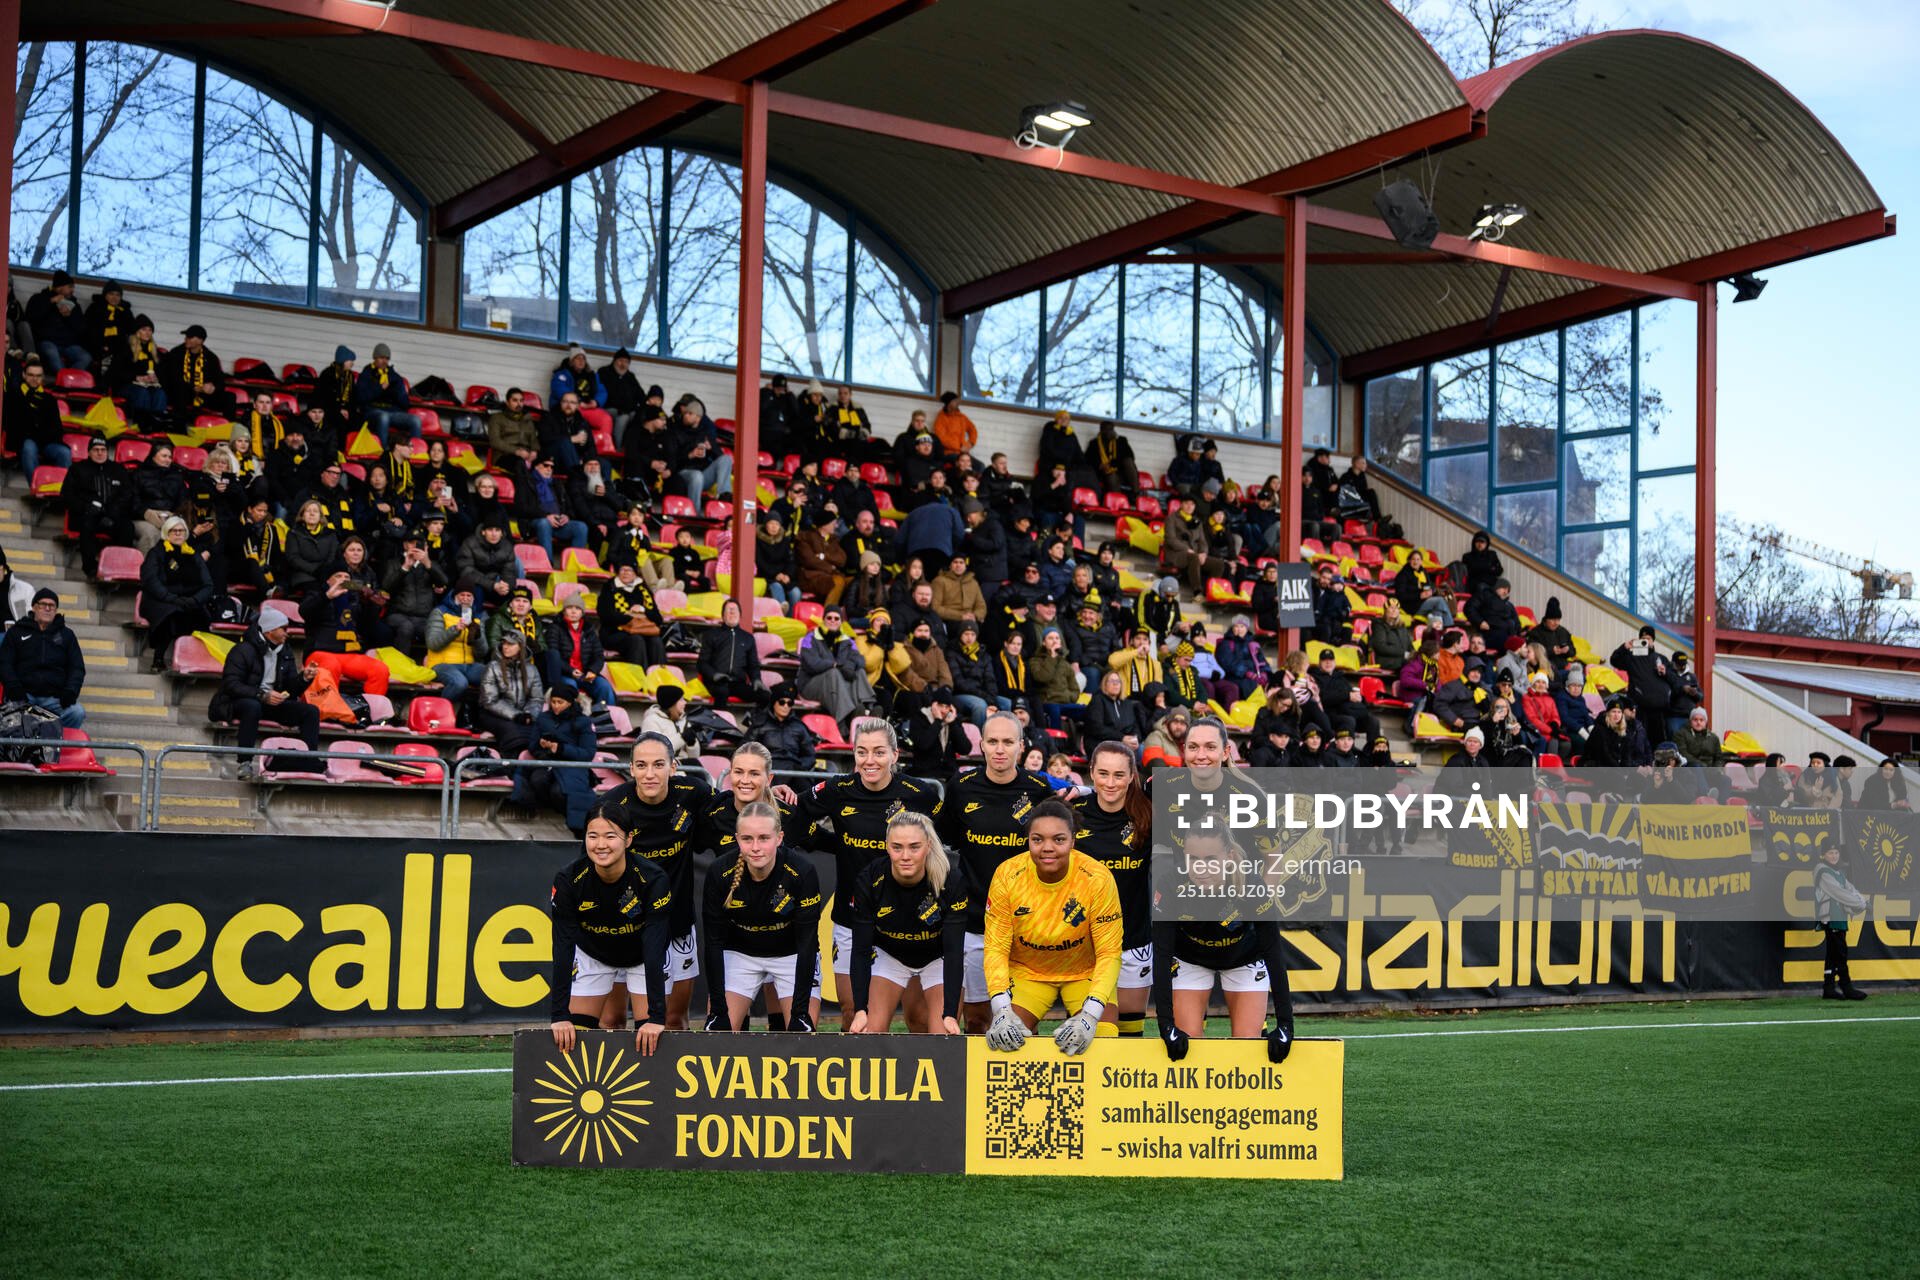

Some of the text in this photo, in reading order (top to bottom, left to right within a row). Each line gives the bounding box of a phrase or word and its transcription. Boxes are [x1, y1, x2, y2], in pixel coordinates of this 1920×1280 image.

[1281, 579, 1310, 600] AIK
[1692, 819, 1747, 840] NORDIN
[1769, 809, 1831, 826] Bevara taket
[966, 829, 1028, 847] truecaller
[1452, 852, 1498, 868] GRABUS!
[1543, 870, 1639, 896] SKYTTAN
[1646, 871, 1751, 899] VÅR KAPTEN
[1019, 936, 1086, 951] truecaller
[675, 1055, 943, 1102] SVARTGULA
[1102, 1066, 1283, 1091] Stötta AIK Fotbolls
[1101, 1100, 1318, 1130] samhällsengagemang
[675, 1114, 855, 1161] FONDEN
[1118, 1136, 1182, 1160] swisha
[1188, 1136, 1241, 1160] valfri
[1246, 1144, 1318, 1161] summa
